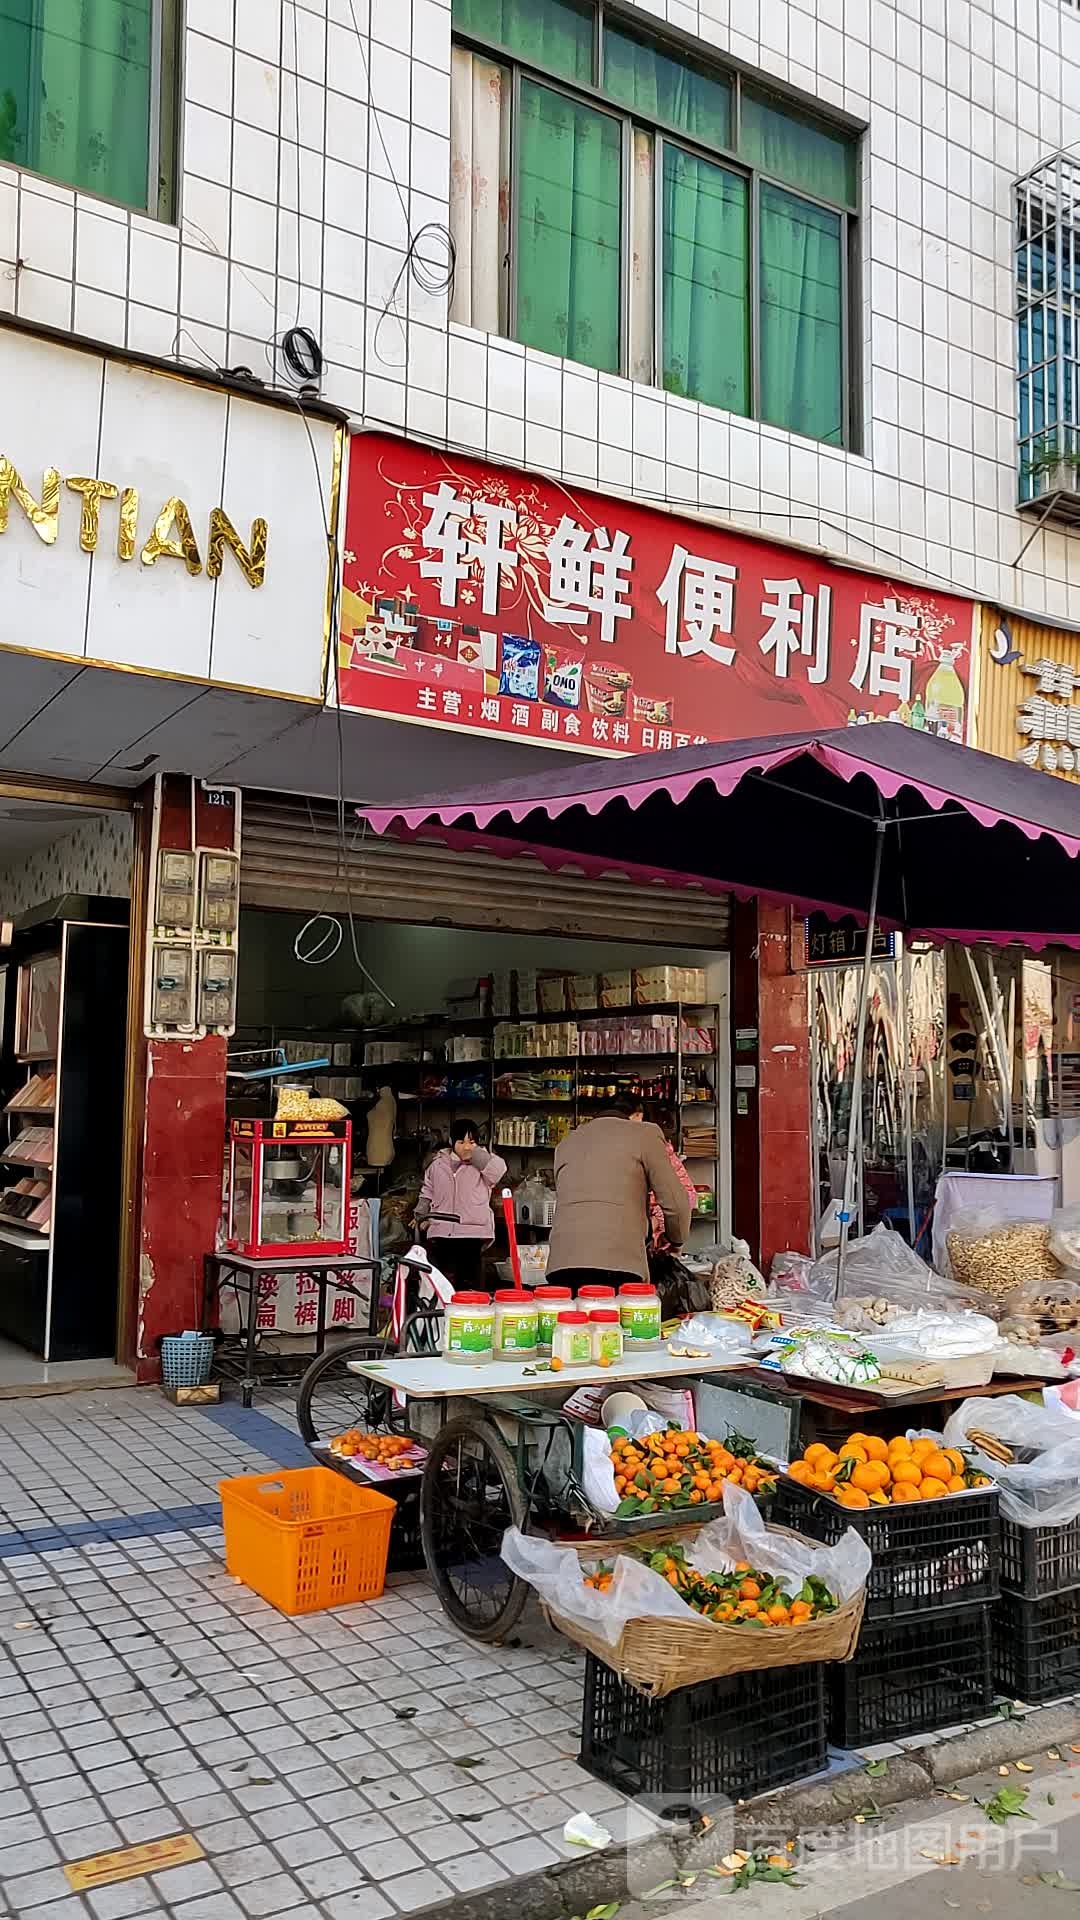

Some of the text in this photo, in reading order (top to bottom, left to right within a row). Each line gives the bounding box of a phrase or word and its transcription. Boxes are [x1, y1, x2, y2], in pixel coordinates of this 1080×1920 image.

[0, 455, 269, 588] NTIAN
[419, 482, 919, 701] 轩鲜便利店
[511, 703, 530, 728] 酒
[541, 708, 582, 737] 副食
[591, 717, 630, 745] 饮料
[553, 675, 576, 691] OMO
